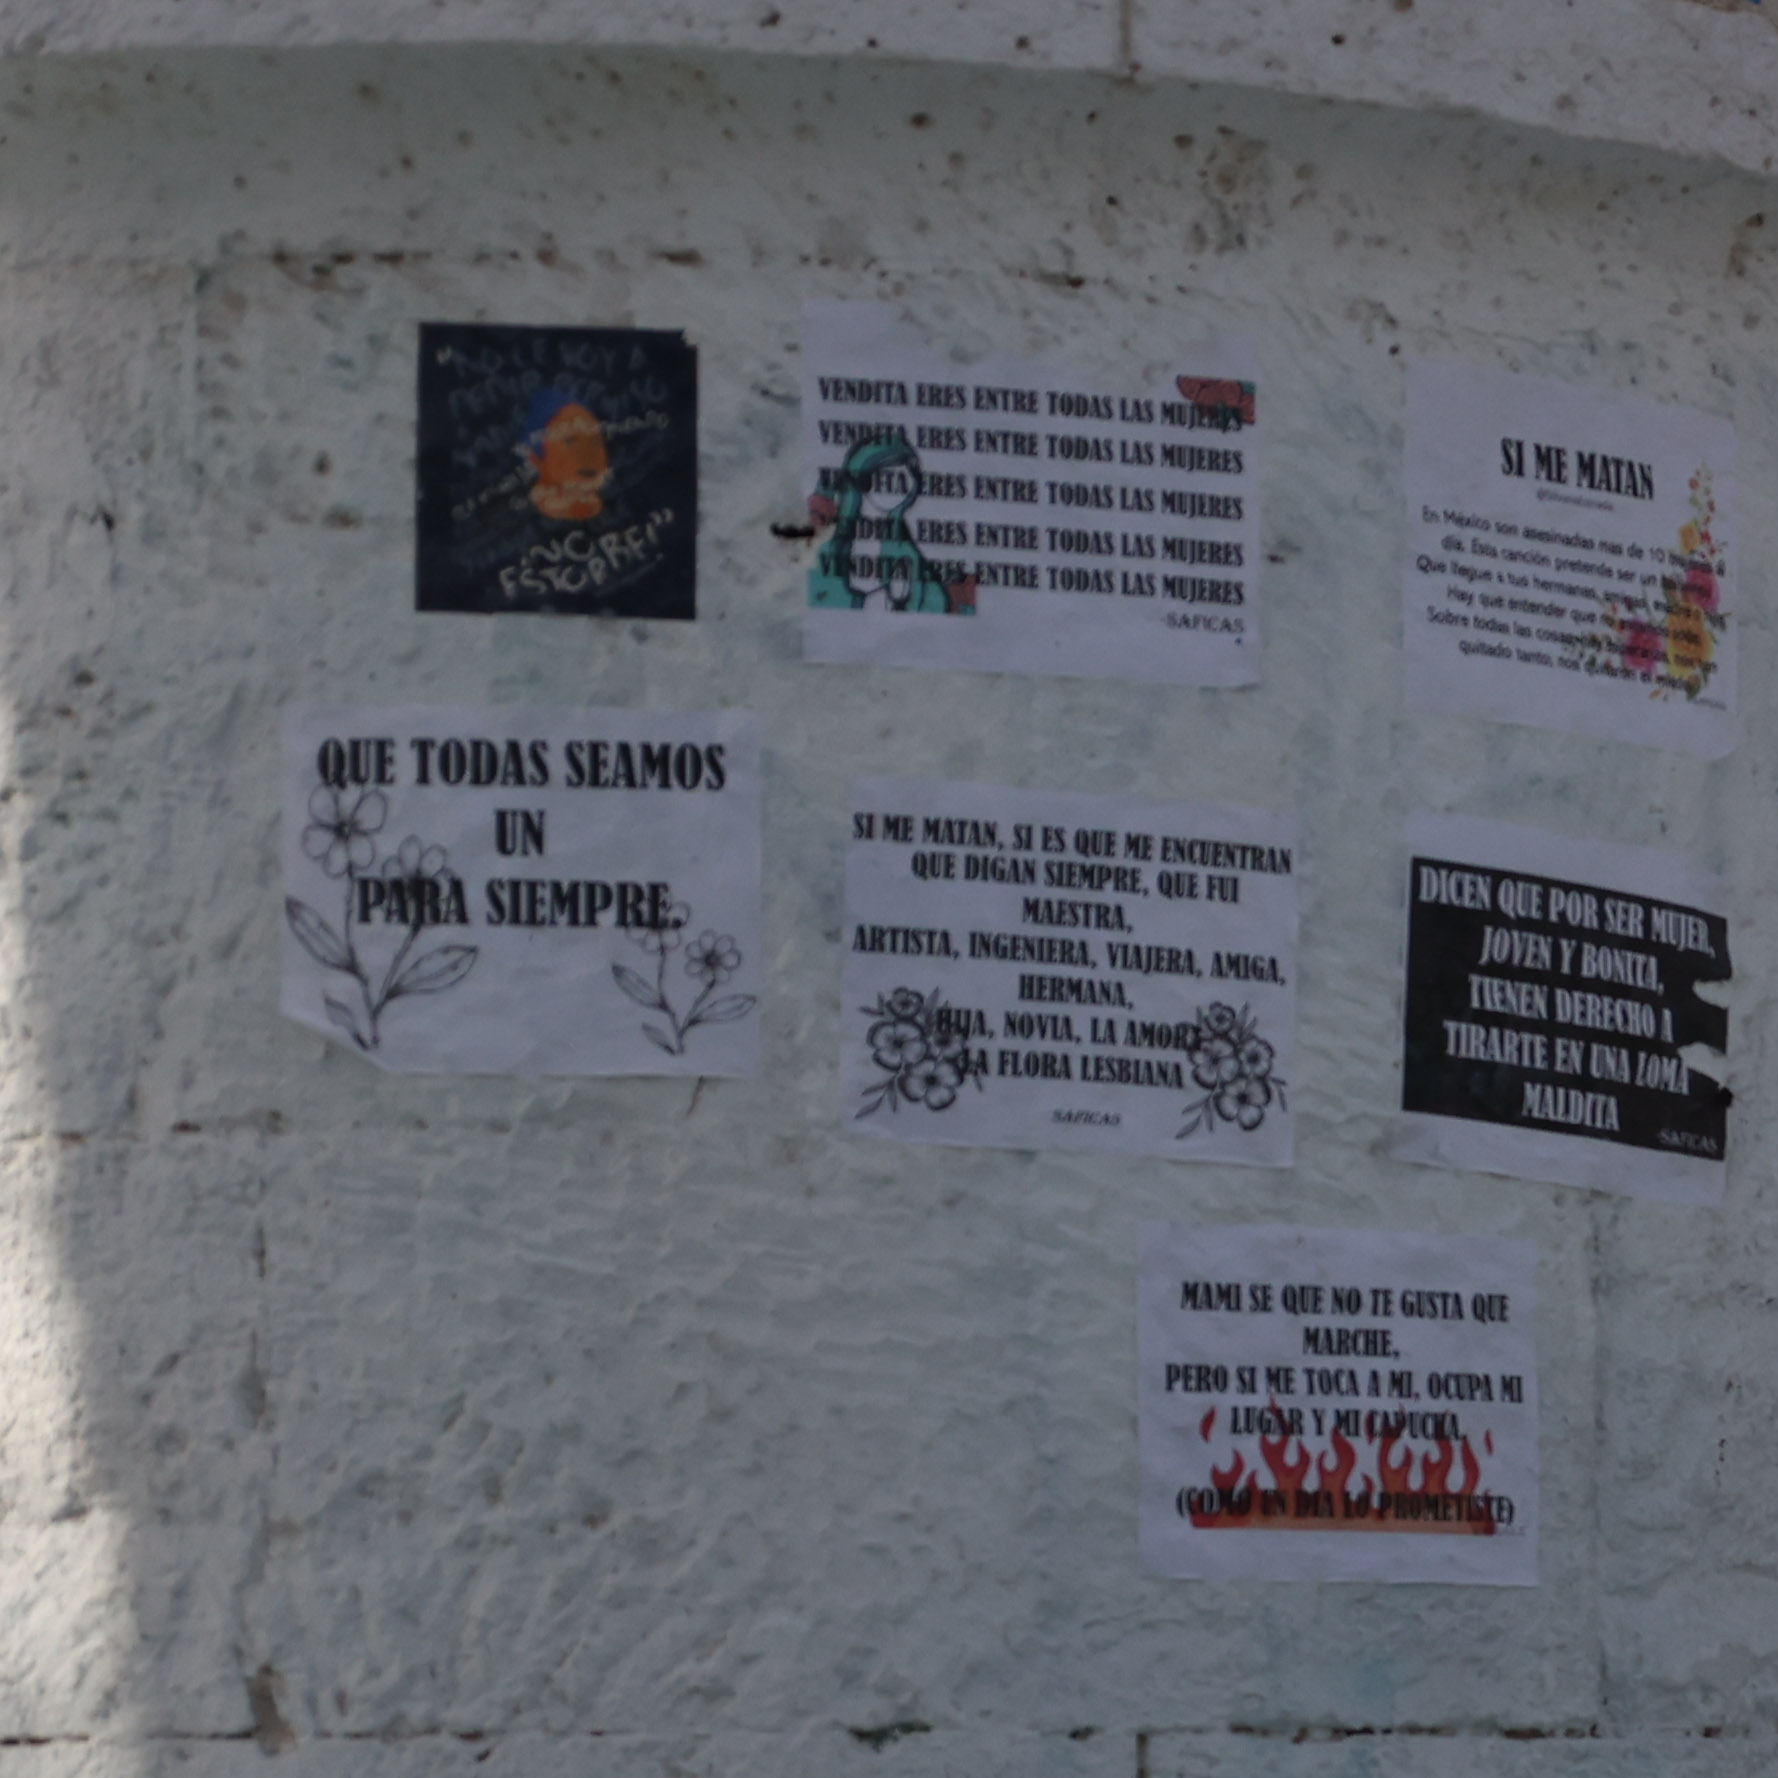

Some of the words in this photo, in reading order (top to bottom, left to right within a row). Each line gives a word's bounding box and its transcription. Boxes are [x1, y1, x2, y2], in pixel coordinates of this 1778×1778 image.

[817, 375, 909, 404] VENDITA
[915, 382, 968, 410] ERES
[973, 385, 1039, 415] ENTRE
[1046, 390, 1114, 422] TODAS
[1118, 397, 1155, 424] LAS
[916, 425, 968, 452] ERES
[973, 428, 1039, 458] ENTRE
[1045, 433, 1114, 464] TODAS
[1118, 440, 1155, 467] LAS
[1159, 443, 1244, 475] MUJERES
[1500, 436, 1525, 479] SI
[1533, 442, 1568, 486] ME
[1575, 450, 1655, 501] MATAN
[917, 469, 968, 498] ERES
[973, 473, 1039, 504] ENTRE
[1045, 478, 1114, 511] TODAS
[1118, 486, 1155, 513] LAS
[1159, 489, 1244, 521] MUJERES
[917, 518, 968, 546] ERES
[973, 522, 1039, 551] ENTRE
[1045, 527, 1114, 559] TODAS
[1119, 534, 1155, 561] LAS
[1160, 536, 1244, 569] MUJERES
[974, 562, 1039, 591] ENTRE
[1045, 565, 1114, 598] TODAS
[1120, 571, 1155, 599] LAS
[1160, 574, 1244, 607] MUJERES
[316, 735, 398, 791] QUE
[410, 736, 551, 789] TODAS
[563, 738, 728, 793] SEAMOS
[493, 806, 548, 858] UN
[852, 812, 877, 840] SI
[882, 814, 914, 844] ME
[922, 816, 1003, 850] MATAN,
[1013, 822, 1034, 851] SI
[1041, 824, 1066, 853] ES
[1073, 826, 1118, 857] QUE
[1124, 832, 1154, 862] ME
[1160, 835, 1293, 876] ENCUENTRAN
[911, 850, 956, 881] QUE
[964, 853, 1036, 885] DIGAN
[1044, 859, 1151, 898] SIEMPRE,
[1156, 869, 1199, 899] QUE
[1205, 873, 1241, 904] FUI
[355, 876, 470, 927] PARA
[484, 876, 686, 930] SIEMPRE.
[1021, 896, 1134, 935] MAESTRA,
[1419, 866, 1492, 911] DICEN
[1499, 878, 1543, 919] QUE
[1550, 887, 1600, 930] POR
[1604, 899, 1645, 939] SER
[1651, 908, 1716, 957] MUJER,
[852, 923, 961, 960] ARTISTA,
[968, 929, 1098, 970] INGENIERA,
[1106, 940, 1204, 979] VIAJERA,
[1209, 950, 1287, 987] AMIGA,
[1478, 924, 1553, 971] JOVEN
[1559, 937, 1577, 975] Y
[1581, 942, 1664, 997] BONITA,
[1018, 972, 1134, 1010] HERMANA,
[1468, 973, 1549, 1019] TIENEN
[1554, 987, 1655, 1038] DERECHO
[1660, 1008, 1674, 1043] A
[1003, 1010, 1082, 1045] NOVIA,
[1089, 1016, 1117, 1046] LA
[997, 1049, 1072, 1081] FLORA
[1080, 1054, 1184, 1090] LESBIANA
[1443, 1019, 1549, 1070] TIRARTE
[1554, 1037, 1585, 1075] EN
[1589, 1041, 1631, 1083] UNA
[1635, 1051, 1690, 1095] LOMA
[1522, 1081, 1621, 1131] MALDITA
[1180, 1279, 1243, 1312] MAMI
[1247, 1282, 1274, 1315] SE
[1280, 1282, 1326, 1317] QUE
[1330, 1285, 1364, 1317] NO
[1368, 1286, 1395, 1318] TE
[1401, 1288, 1465, 1321] GUSTA
[1470, 1292, 1511, 1325] QUE
[1302, 1326, 1402, 1361] MARCHE,
[1164, 1361, 1230, 1395] PERO
[1235, 1364, 1258, 1395] SI
[1265, 1364, 1297, 1396] ME
[1302, 1366, 1361, 1398] TOCA
[1366, 1368, 1382, 1398] A
[1426, 1370, 1494, 1402] OCUPA
[1500, 1373, 1524, 1404] MI
[1230, 1404, 1306, 1437] LUGAR
[1311, 1406, 1328, 1436] Y
[1333, 1408, 1361, 1438] MI
